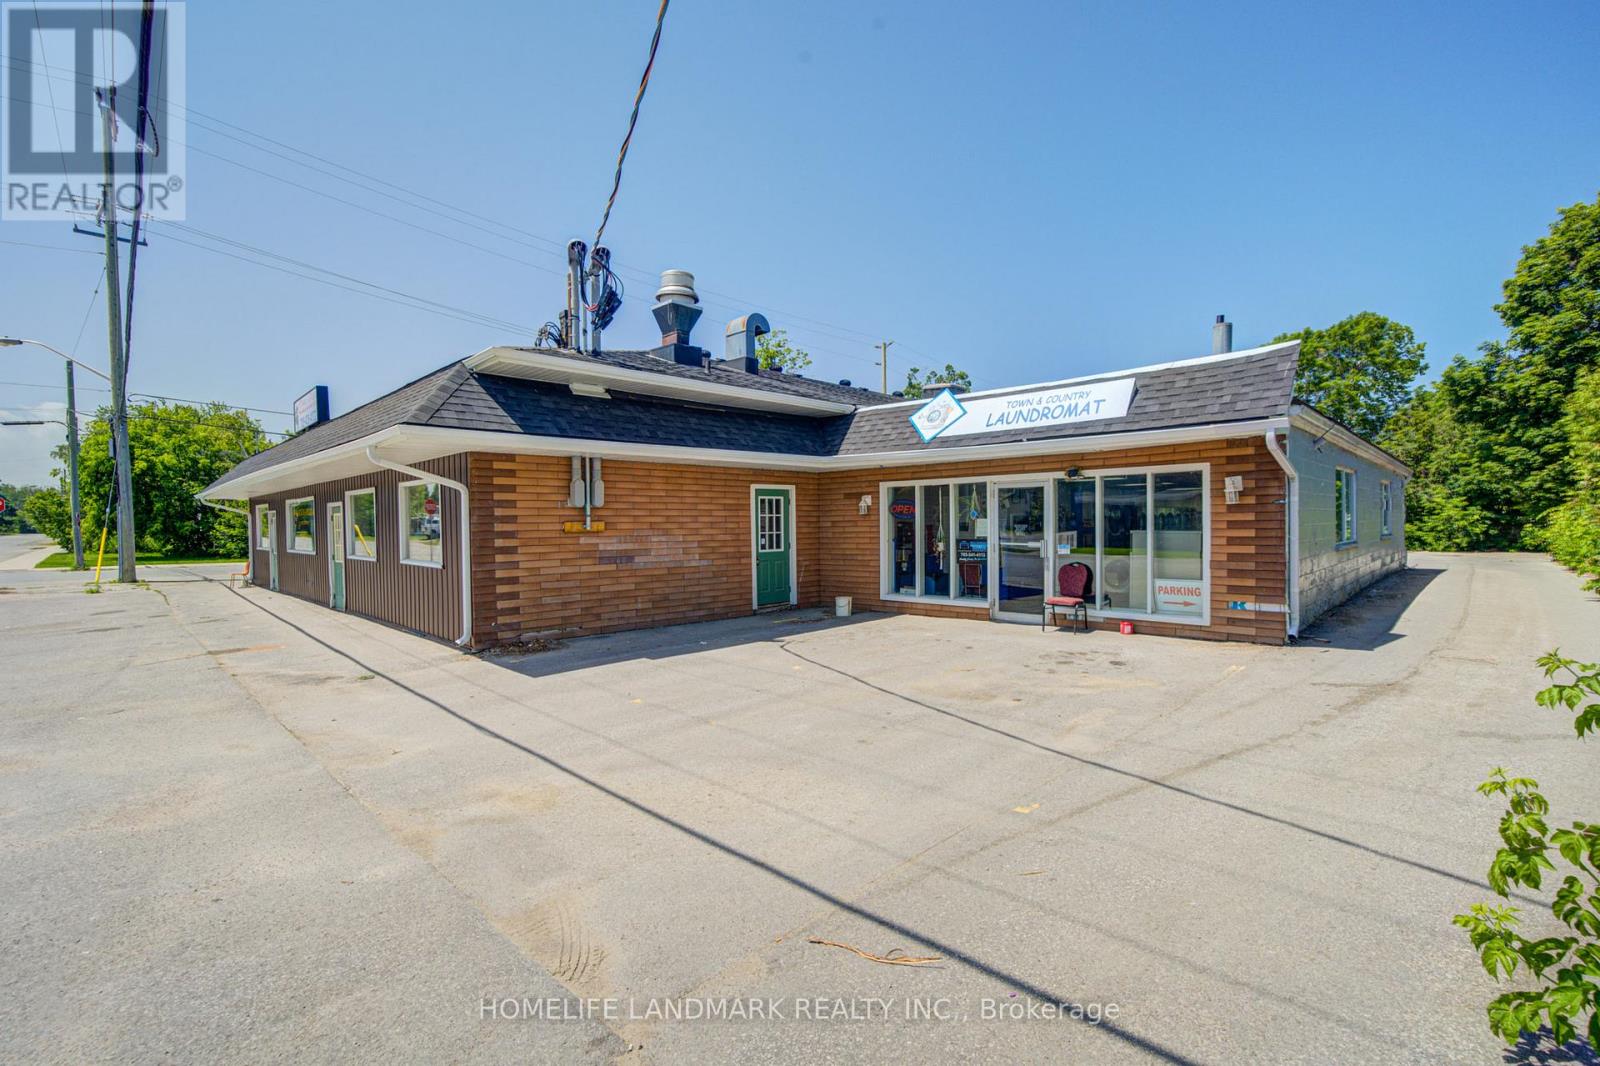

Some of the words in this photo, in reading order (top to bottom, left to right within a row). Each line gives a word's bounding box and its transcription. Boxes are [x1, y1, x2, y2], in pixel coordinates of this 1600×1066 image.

[1006, 399, 1034, 409] TOWN
[1036, 397, 1042, 406] &
[1045, 390, 1092, 404] COUNTRY
[985, 398, 1107, 427] LAUNDROMAT
[1157, 585, 1202, 597] PARKING
